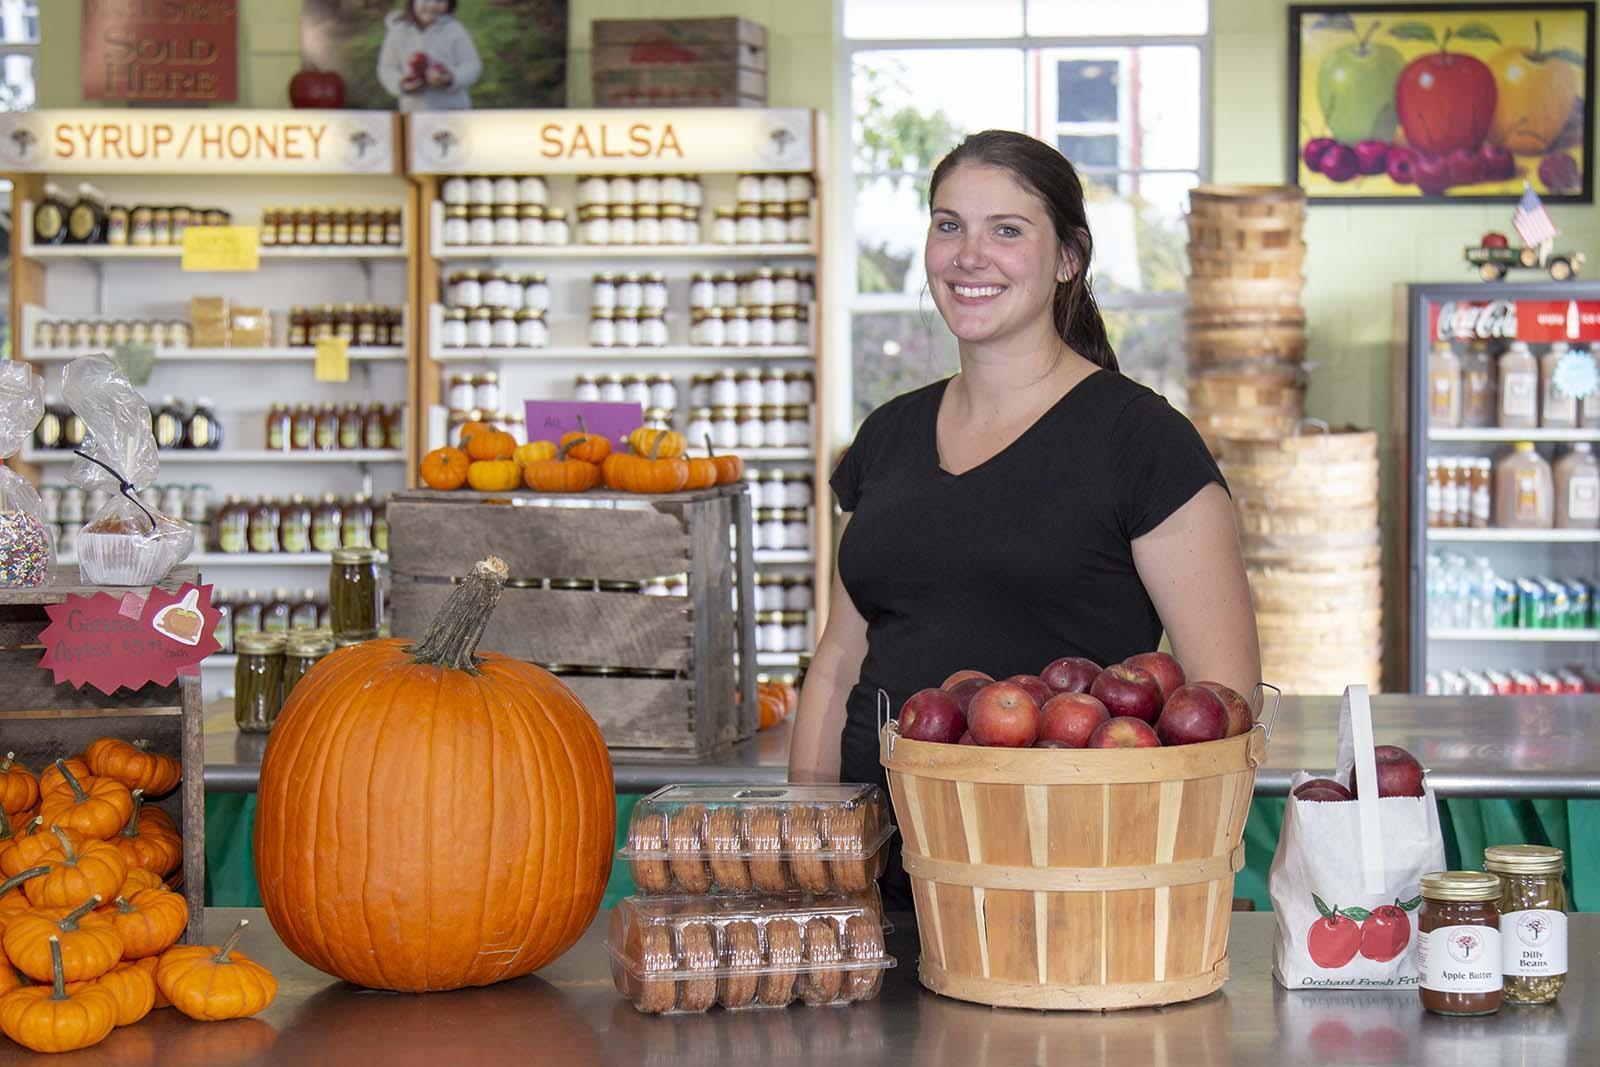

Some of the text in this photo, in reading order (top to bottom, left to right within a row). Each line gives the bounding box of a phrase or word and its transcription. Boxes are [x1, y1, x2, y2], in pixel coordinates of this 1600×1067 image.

[104, 28, 219, 65] SOLD
[104, 64, 219, 97] HERE
[55, 123, 327, 159] SYRUP/HONEY
[540, 123, 684, 158] SALSA
[1520, 959, 1548, 967] Beans
[1522, 951, 1543, 960] Dilly
[1302, 975, 1419, 986] Orchard Fresh Fru
[1442, 970, 1493, 981] Apple Butter
